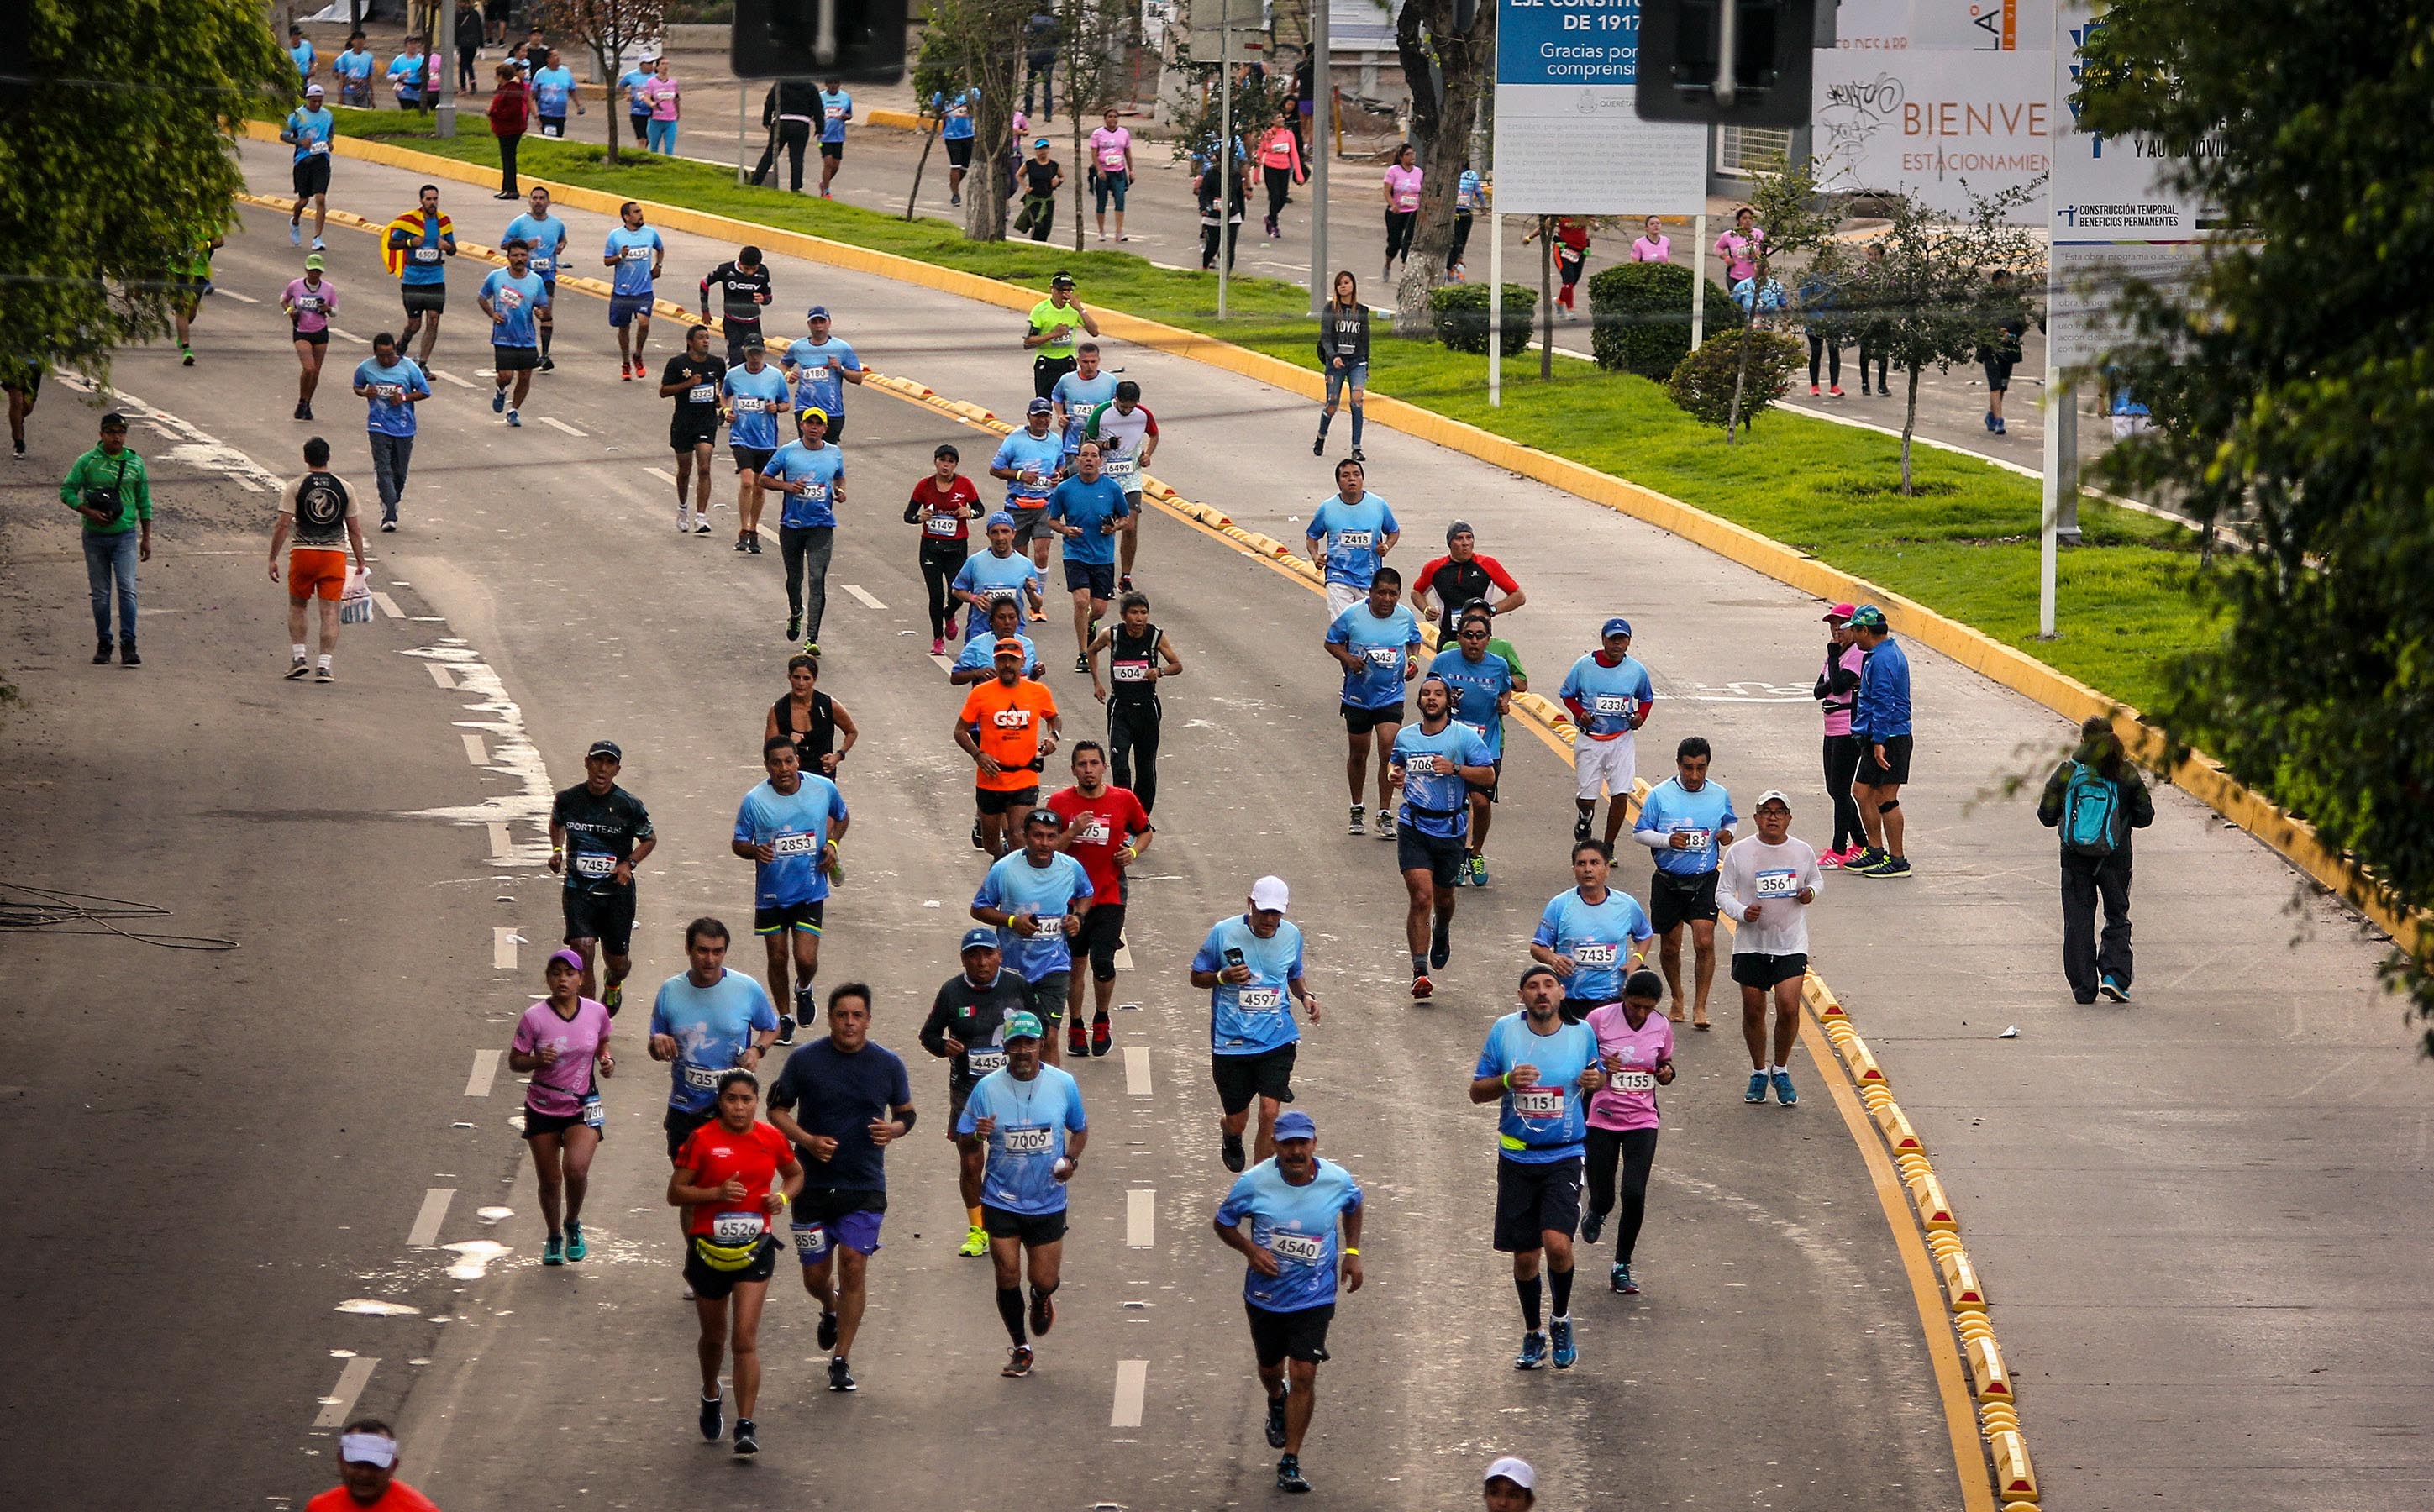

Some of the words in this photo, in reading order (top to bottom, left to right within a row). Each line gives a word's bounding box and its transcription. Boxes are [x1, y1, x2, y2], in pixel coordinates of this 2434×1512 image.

[1564, 14, 1590, 30] DE
[1540, 42, 1603, 58] Gracias
[1548, 61, 1638, 80] comprensi
[1904, 102, 2048, 136] BIENVE
[2134, 139, 2144, 158] Y
[2079, 203, 2136, 215] CONSTRUCCIÓN
[2137, 204, 2179, 216] TEMPORAL,
[2079, 216, 2122, 227] BENEFICIOS
[2123, 216, 2179, 227] PERMANENTES
[805, 369, 826, 378] 6180
[691, 389, 713, 399] 3325
[739, 400, 761, 410] 3443
[1108, 464, 1130, 473] 6499
[930, 520, 954, 530] 4149
[1344, 535, 1369, 544] 2418
[1120, 669, 1141, 678] 604
[1601, 699, 1626, 711] 2336
[992, 710, 1032, 727] G3T
[565, 821, 595, 833] SPORT
[781, 840, 812, 852] 2853
[581, 859, 611, 872] 7452
[1762, 878, 1792, 890] 3561
[1580, 949, 1613, 962] 7435
[1244, 994, 1276, 1006] 4597
[975, 1056, 1008, 1069] 4454
[1617, 1075, 1648, 1088] 1155
[1523, 1096, 1556, 1110] 1151
[1009, 1133, 1047, 1149] 7009
[719, 1221, 757, 1236] 6526
[1276, 1238, 1317, 1258] 4540
